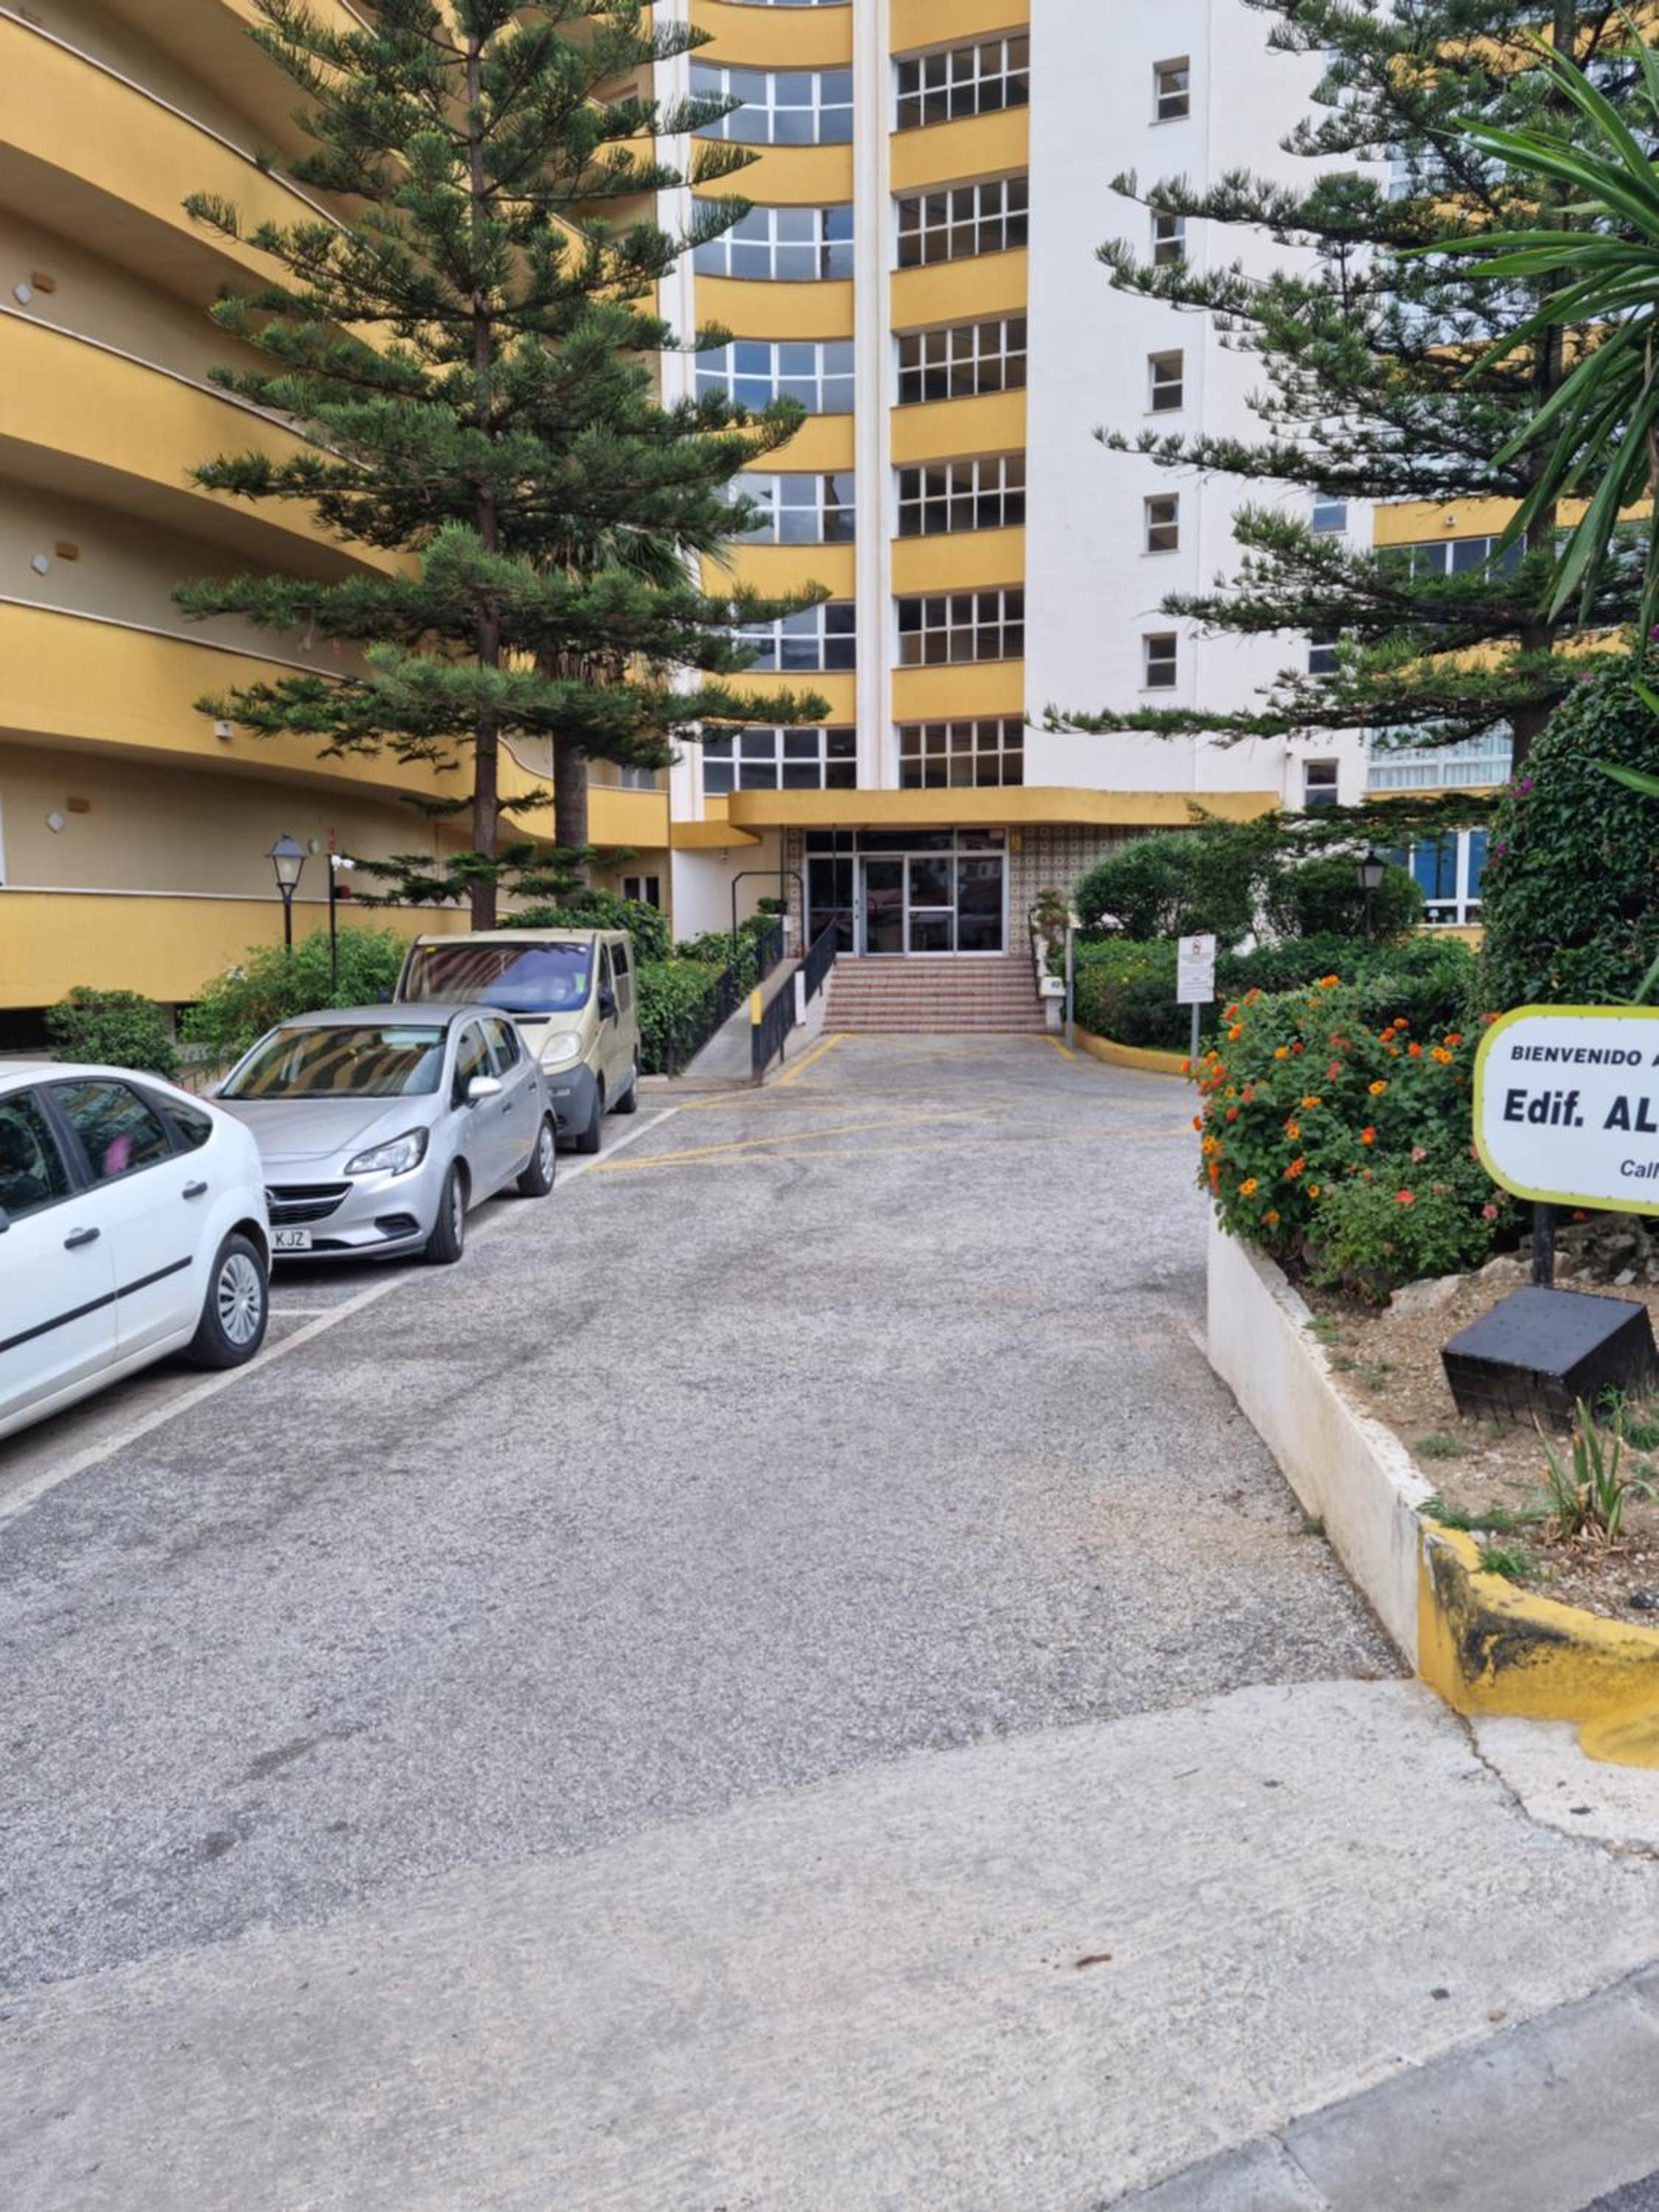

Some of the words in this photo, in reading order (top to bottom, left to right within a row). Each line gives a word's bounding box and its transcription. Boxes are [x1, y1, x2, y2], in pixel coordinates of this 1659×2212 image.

[1511, 1046, 1642, 1066] BIENVENIDO
[1503, 1088, 1584, 1127] Edif.
[275, 1231, 305, 1247] KJZ
